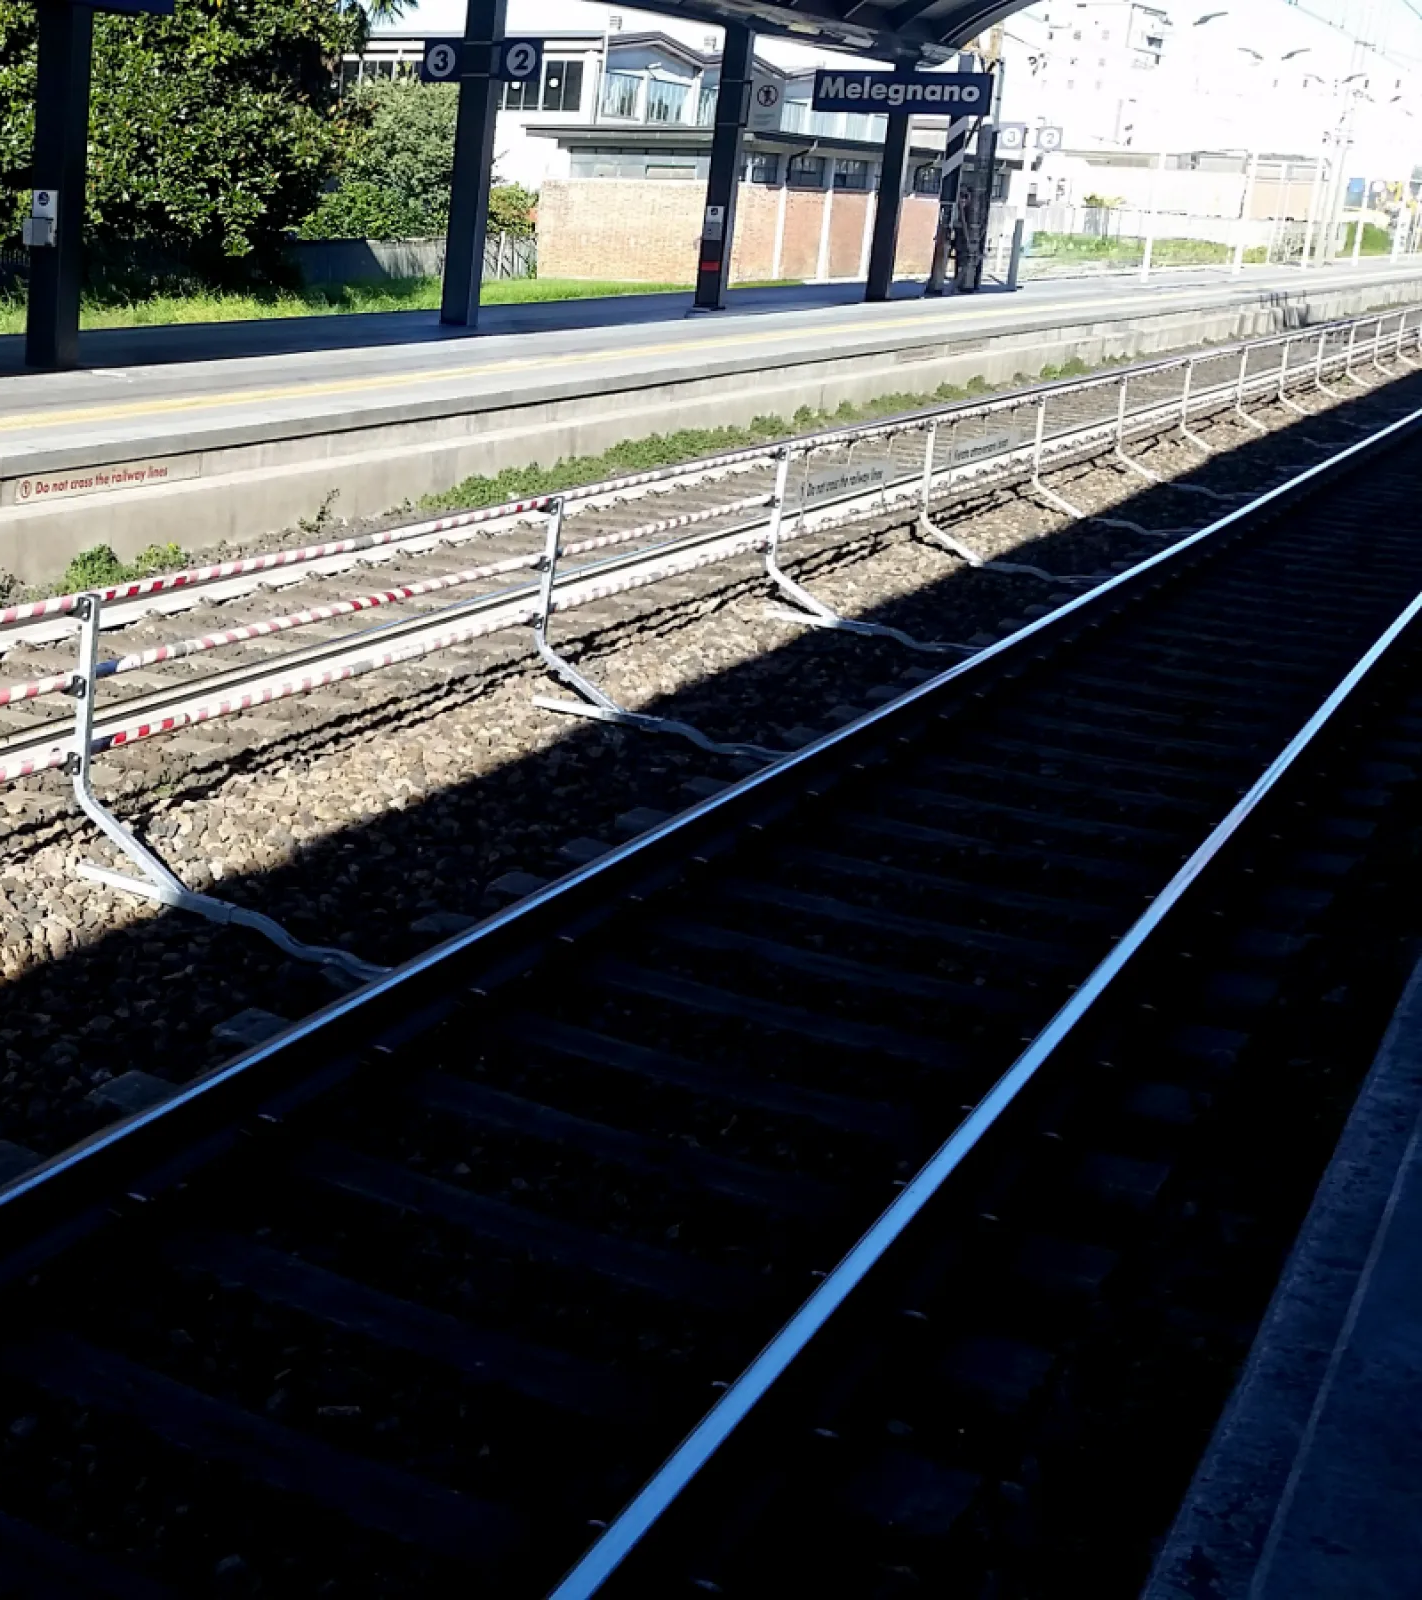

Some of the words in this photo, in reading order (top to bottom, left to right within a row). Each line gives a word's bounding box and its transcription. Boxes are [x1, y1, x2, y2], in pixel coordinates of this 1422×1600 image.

[433, 49, 449, 72] 3
[514, 49, 529, 70] 2
[819, 76, 980, 105] Melegnano
[35, 481, 49, 494] Do
[51, 479, 68, 492] not
[70, 477, 93, 490] cross
[95, 472, 109, 485] the
[111, 467, 146, 484] railway
[147, 465, 168, 478] lines
